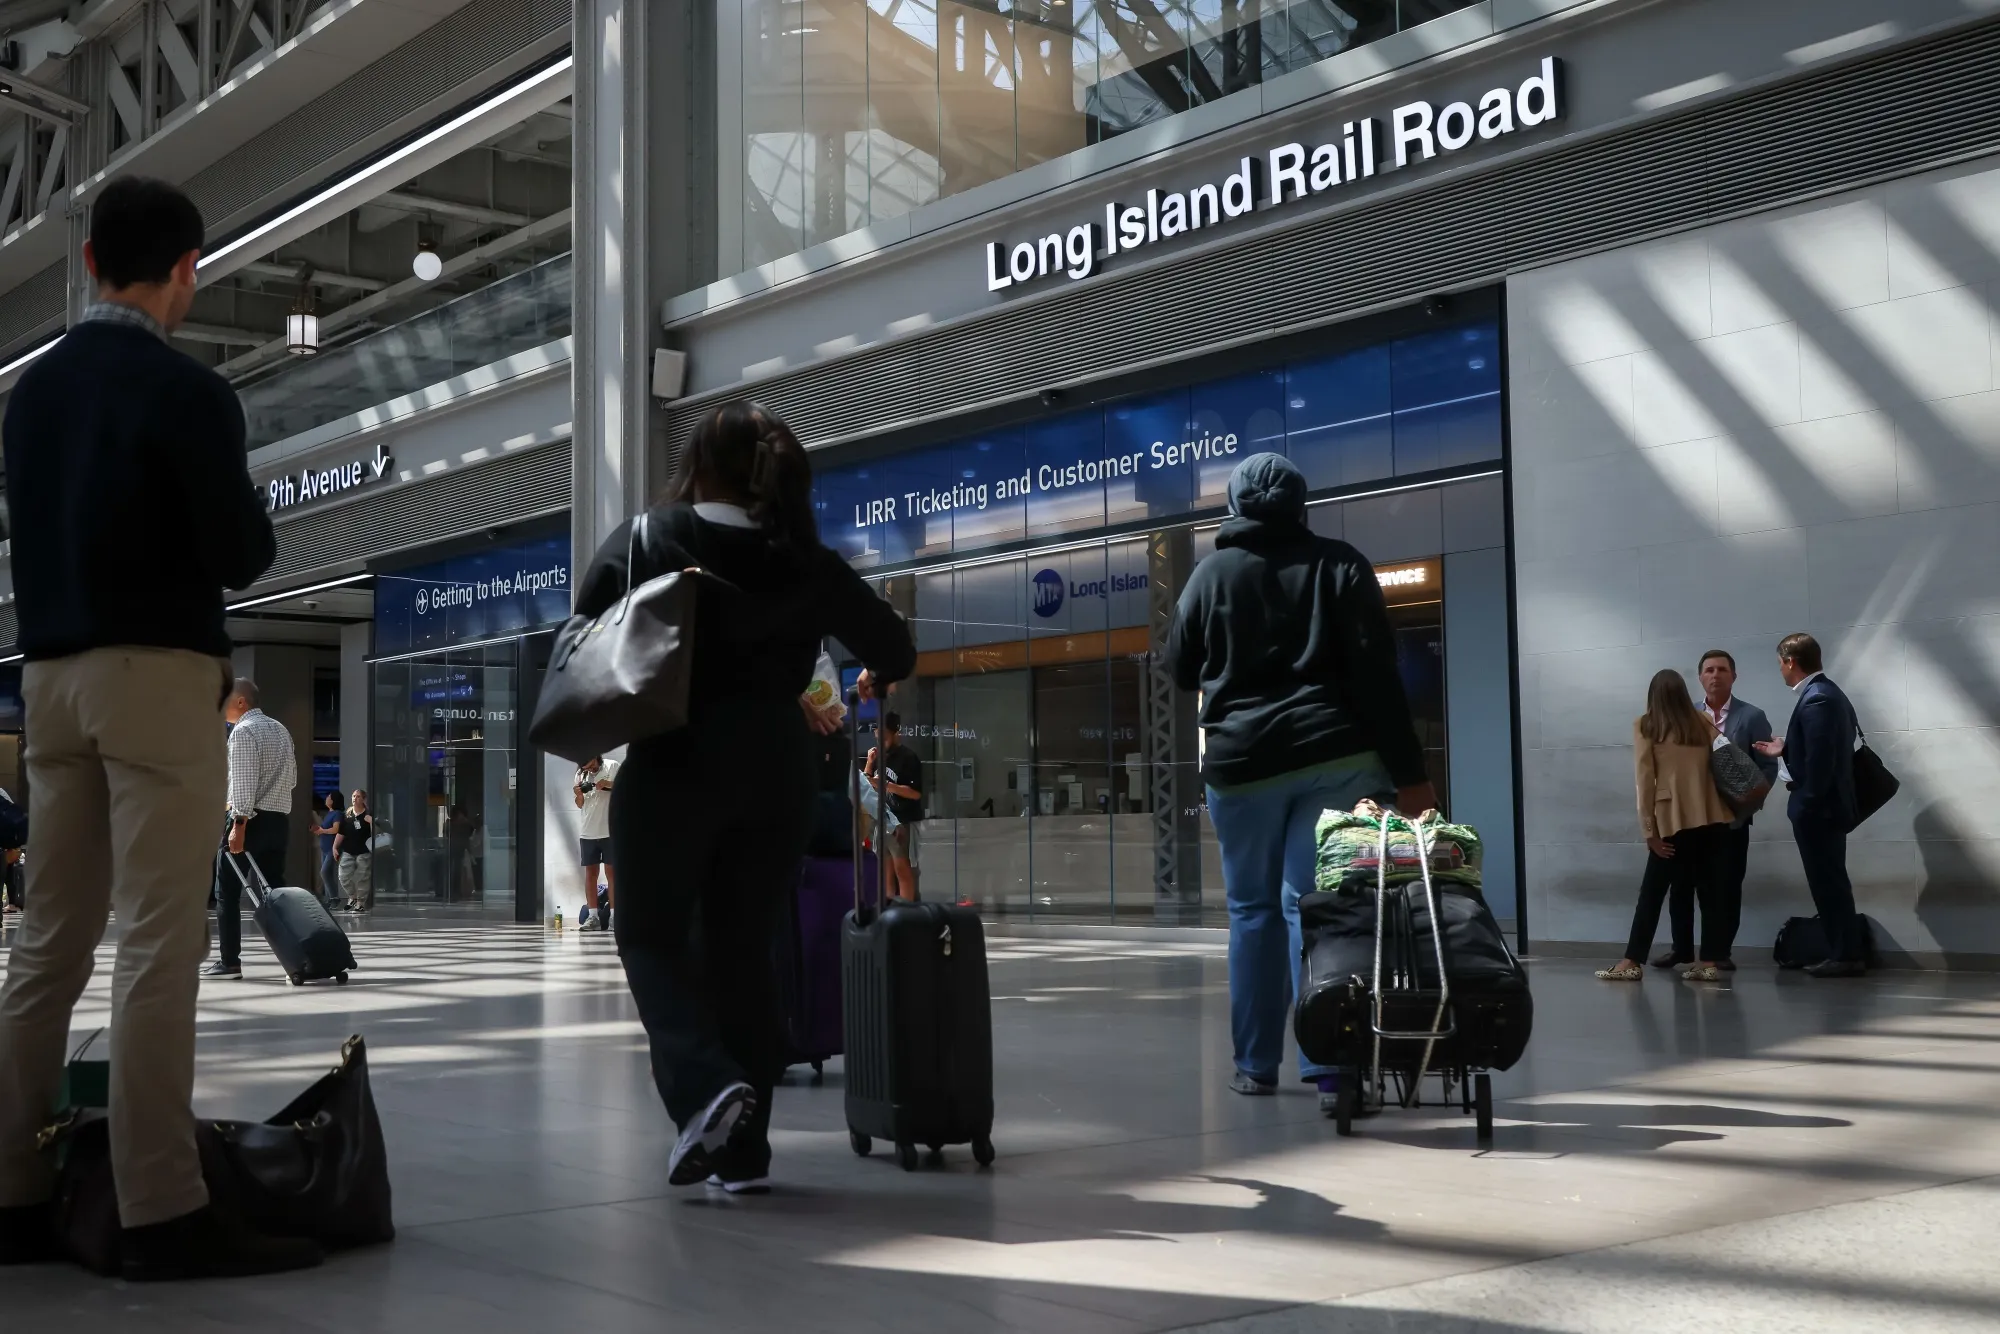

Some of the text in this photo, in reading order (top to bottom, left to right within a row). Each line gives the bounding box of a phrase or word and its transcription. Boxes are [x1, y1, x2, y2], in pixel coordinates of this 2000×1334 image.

[985, 56, 1558, 292] Long Island Rail Road
[269, 461, 362, 510] 9th Avenue
[855, 430, 1238, 528] LIRR Ticketing and Customer Service
[432, 564, 567, 609] Getting to the Airports
[1032, 573, 1148, 609] MTA Long Islan
[1375, 567, 1426, 587] ERVICE
